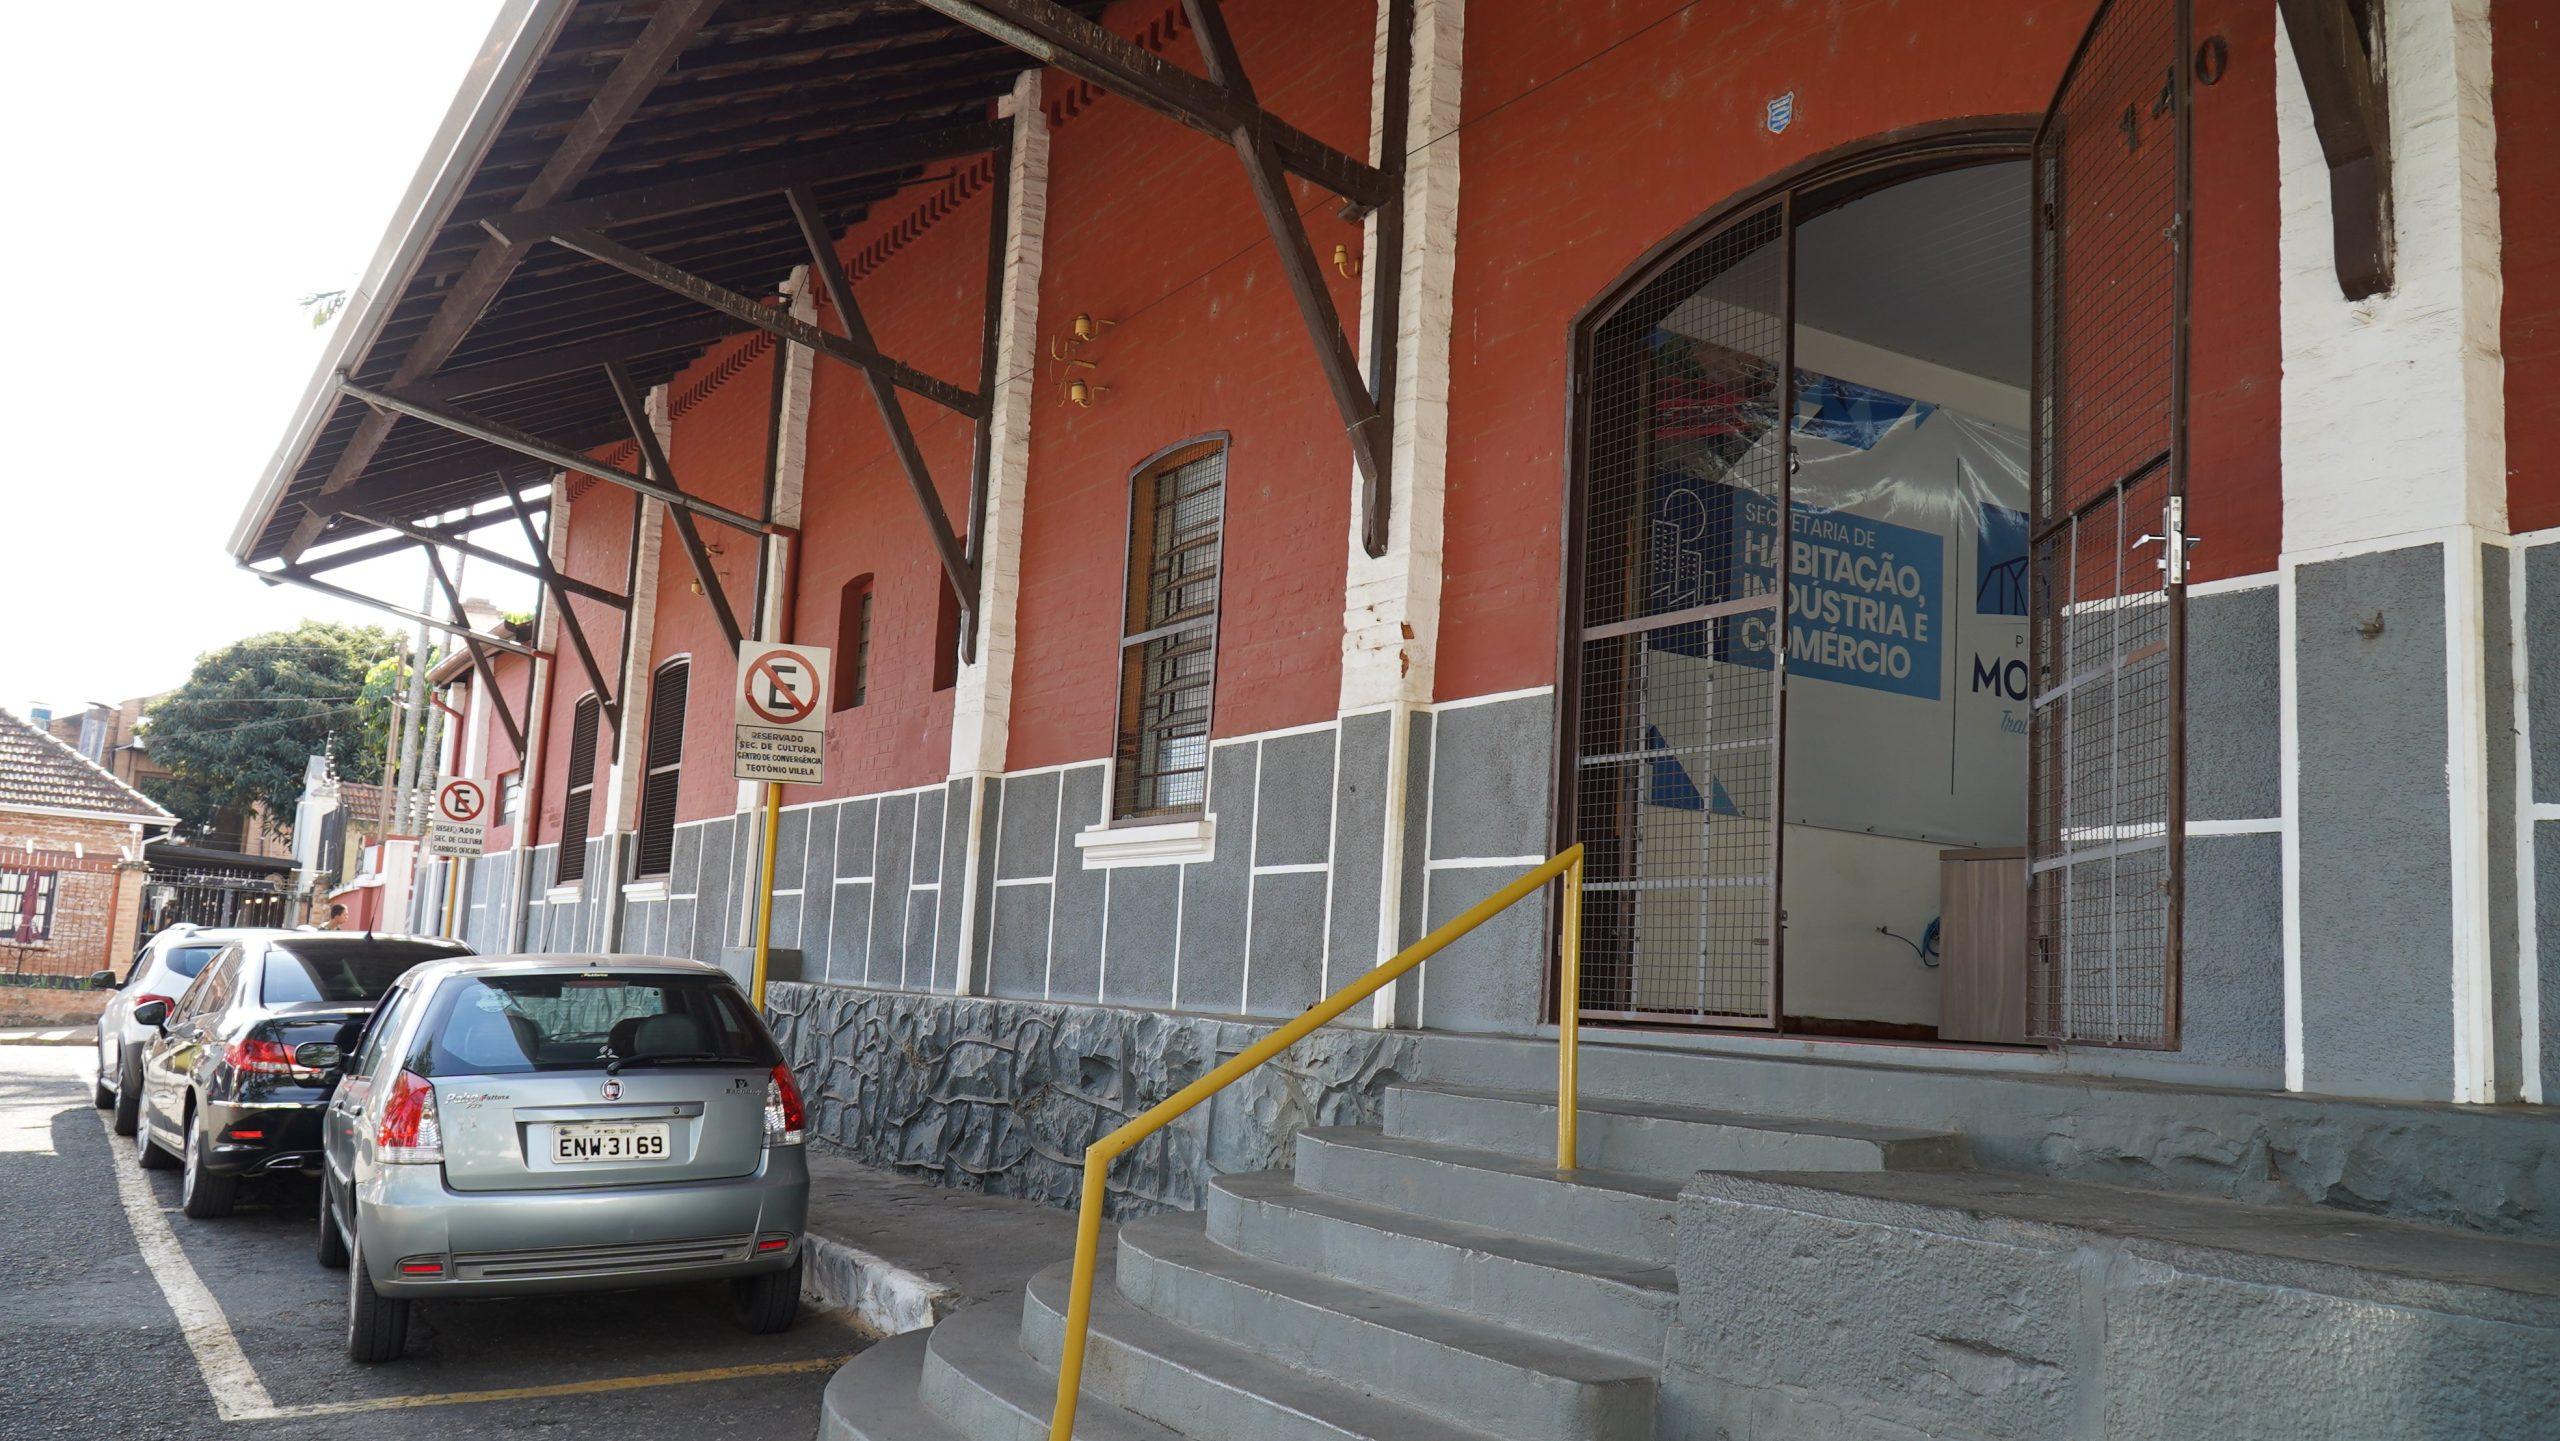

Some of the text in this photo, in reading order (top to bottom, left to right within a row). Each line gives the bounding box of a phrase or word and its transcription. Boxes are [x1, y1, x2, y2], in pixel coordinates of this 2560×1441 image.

[1745, 503, 1876, 549] SECETARIA DE
[1914, 613, 1929, 643] E
[768, 665, 797, 710] E
[751, 732, 804, 743] RESERVADO
[738, 740, 816, 754] SEC. DE CULTURA
[737, 751, 762, 761] CENTRO
[762, 754, 771, 762] DE
[746, 763, 815, 776] TEOTÔNIO VILELA
[454, 789, 470, 812] E
[436, 825, 475, 835] RESERADO
[457, 837, 482, 845] CULTURA
